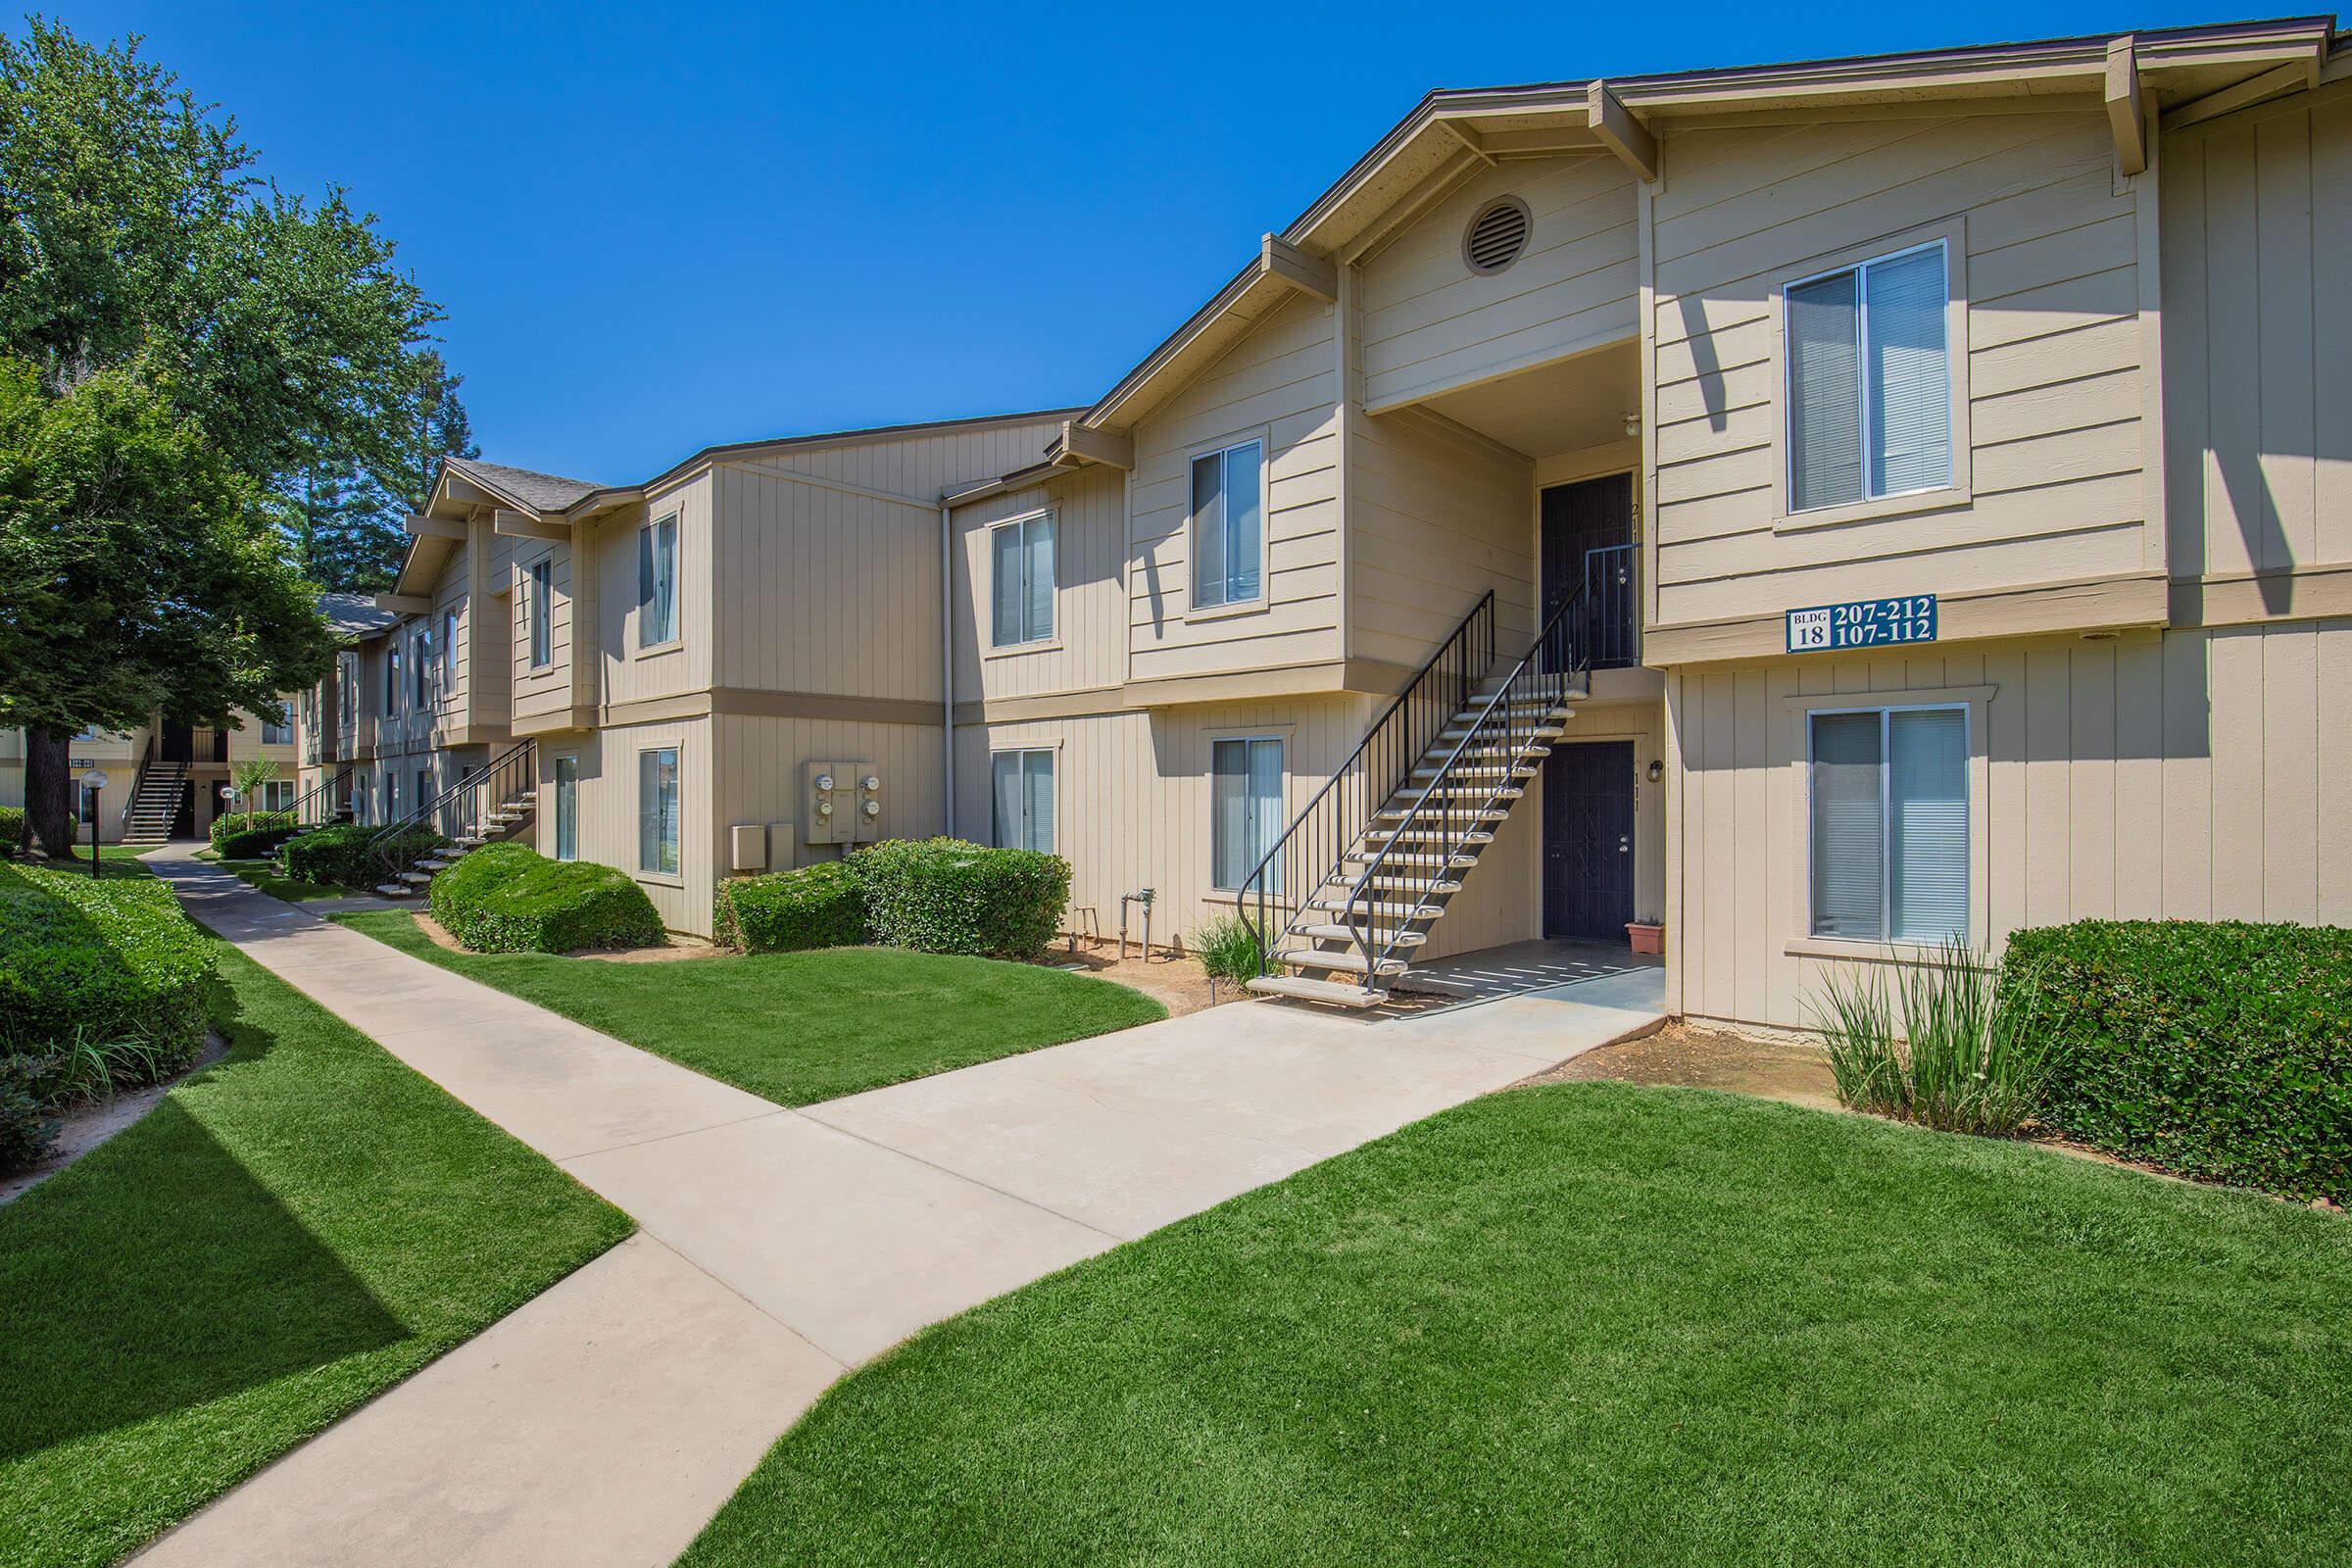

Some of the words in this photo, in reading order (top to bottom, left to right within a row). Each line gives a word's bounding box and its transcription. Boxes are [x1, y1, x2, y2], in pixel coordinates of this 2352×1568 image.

[1794, 612, 1827, 624] BLDG
[1835, 597, 1931, 625] 207-212
[1799, 626, 1824, 645] 18
[1837, 618, 1931, 646] 107-112
